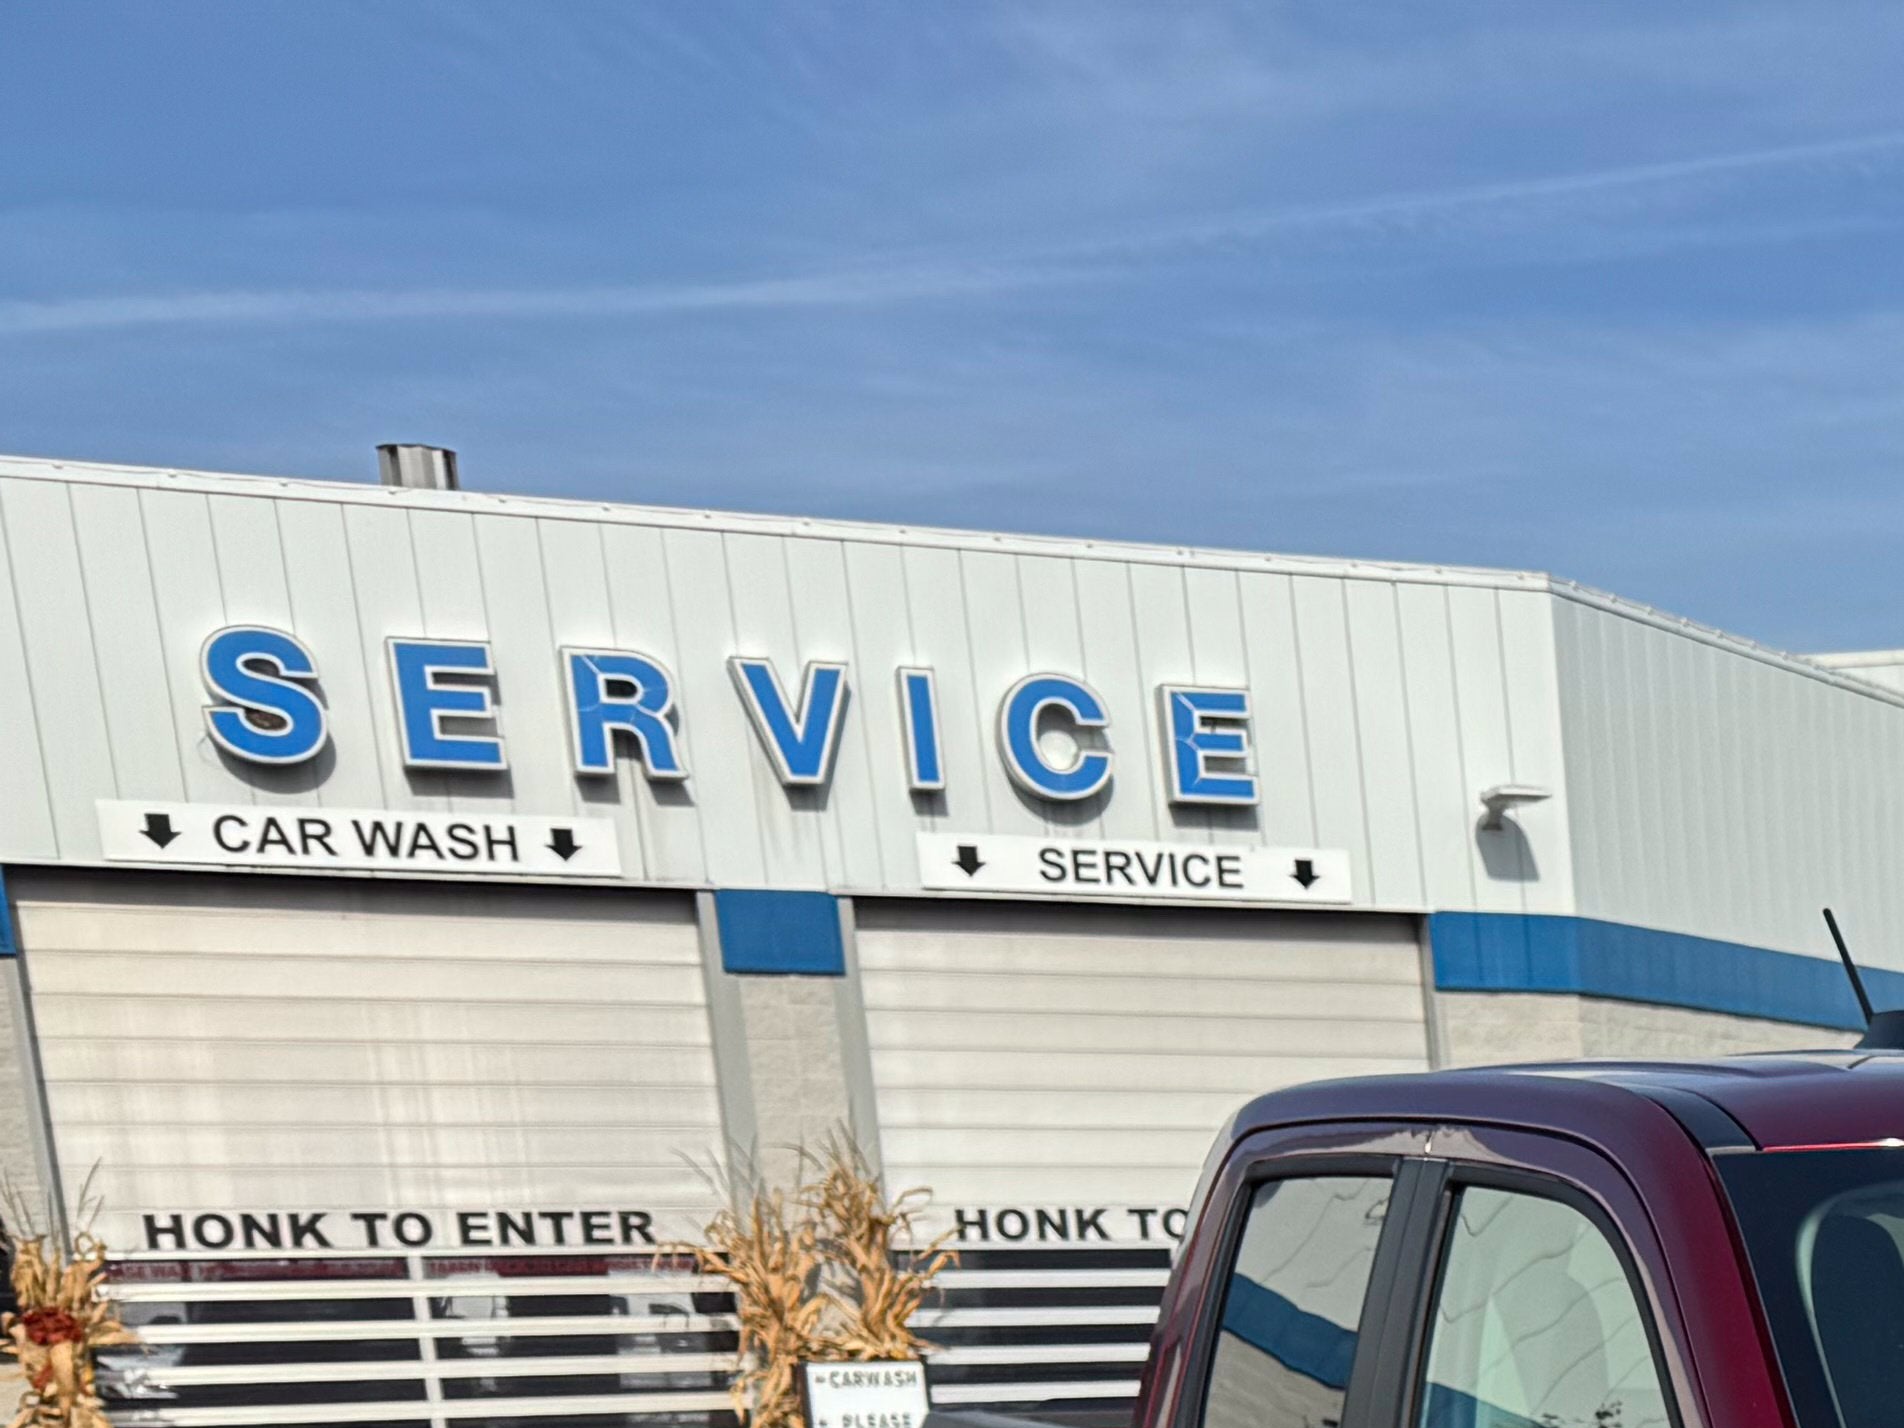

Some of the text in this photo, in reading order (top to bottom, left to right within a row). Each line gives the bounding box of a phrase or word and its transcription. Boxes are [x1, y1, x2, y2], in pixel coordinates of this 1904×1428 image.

[201, 624, 1259, 805] SERVICE
[213, 815, 520, 863] CAR WASH
[1039, 847, 1245, 889] SERVICE
[143, 1209, 659, 1250] HONK TO ENTER
[956, 1206, 1190, 1242] HONK TO
[829, 1369, 917, 1389] CARWASH
